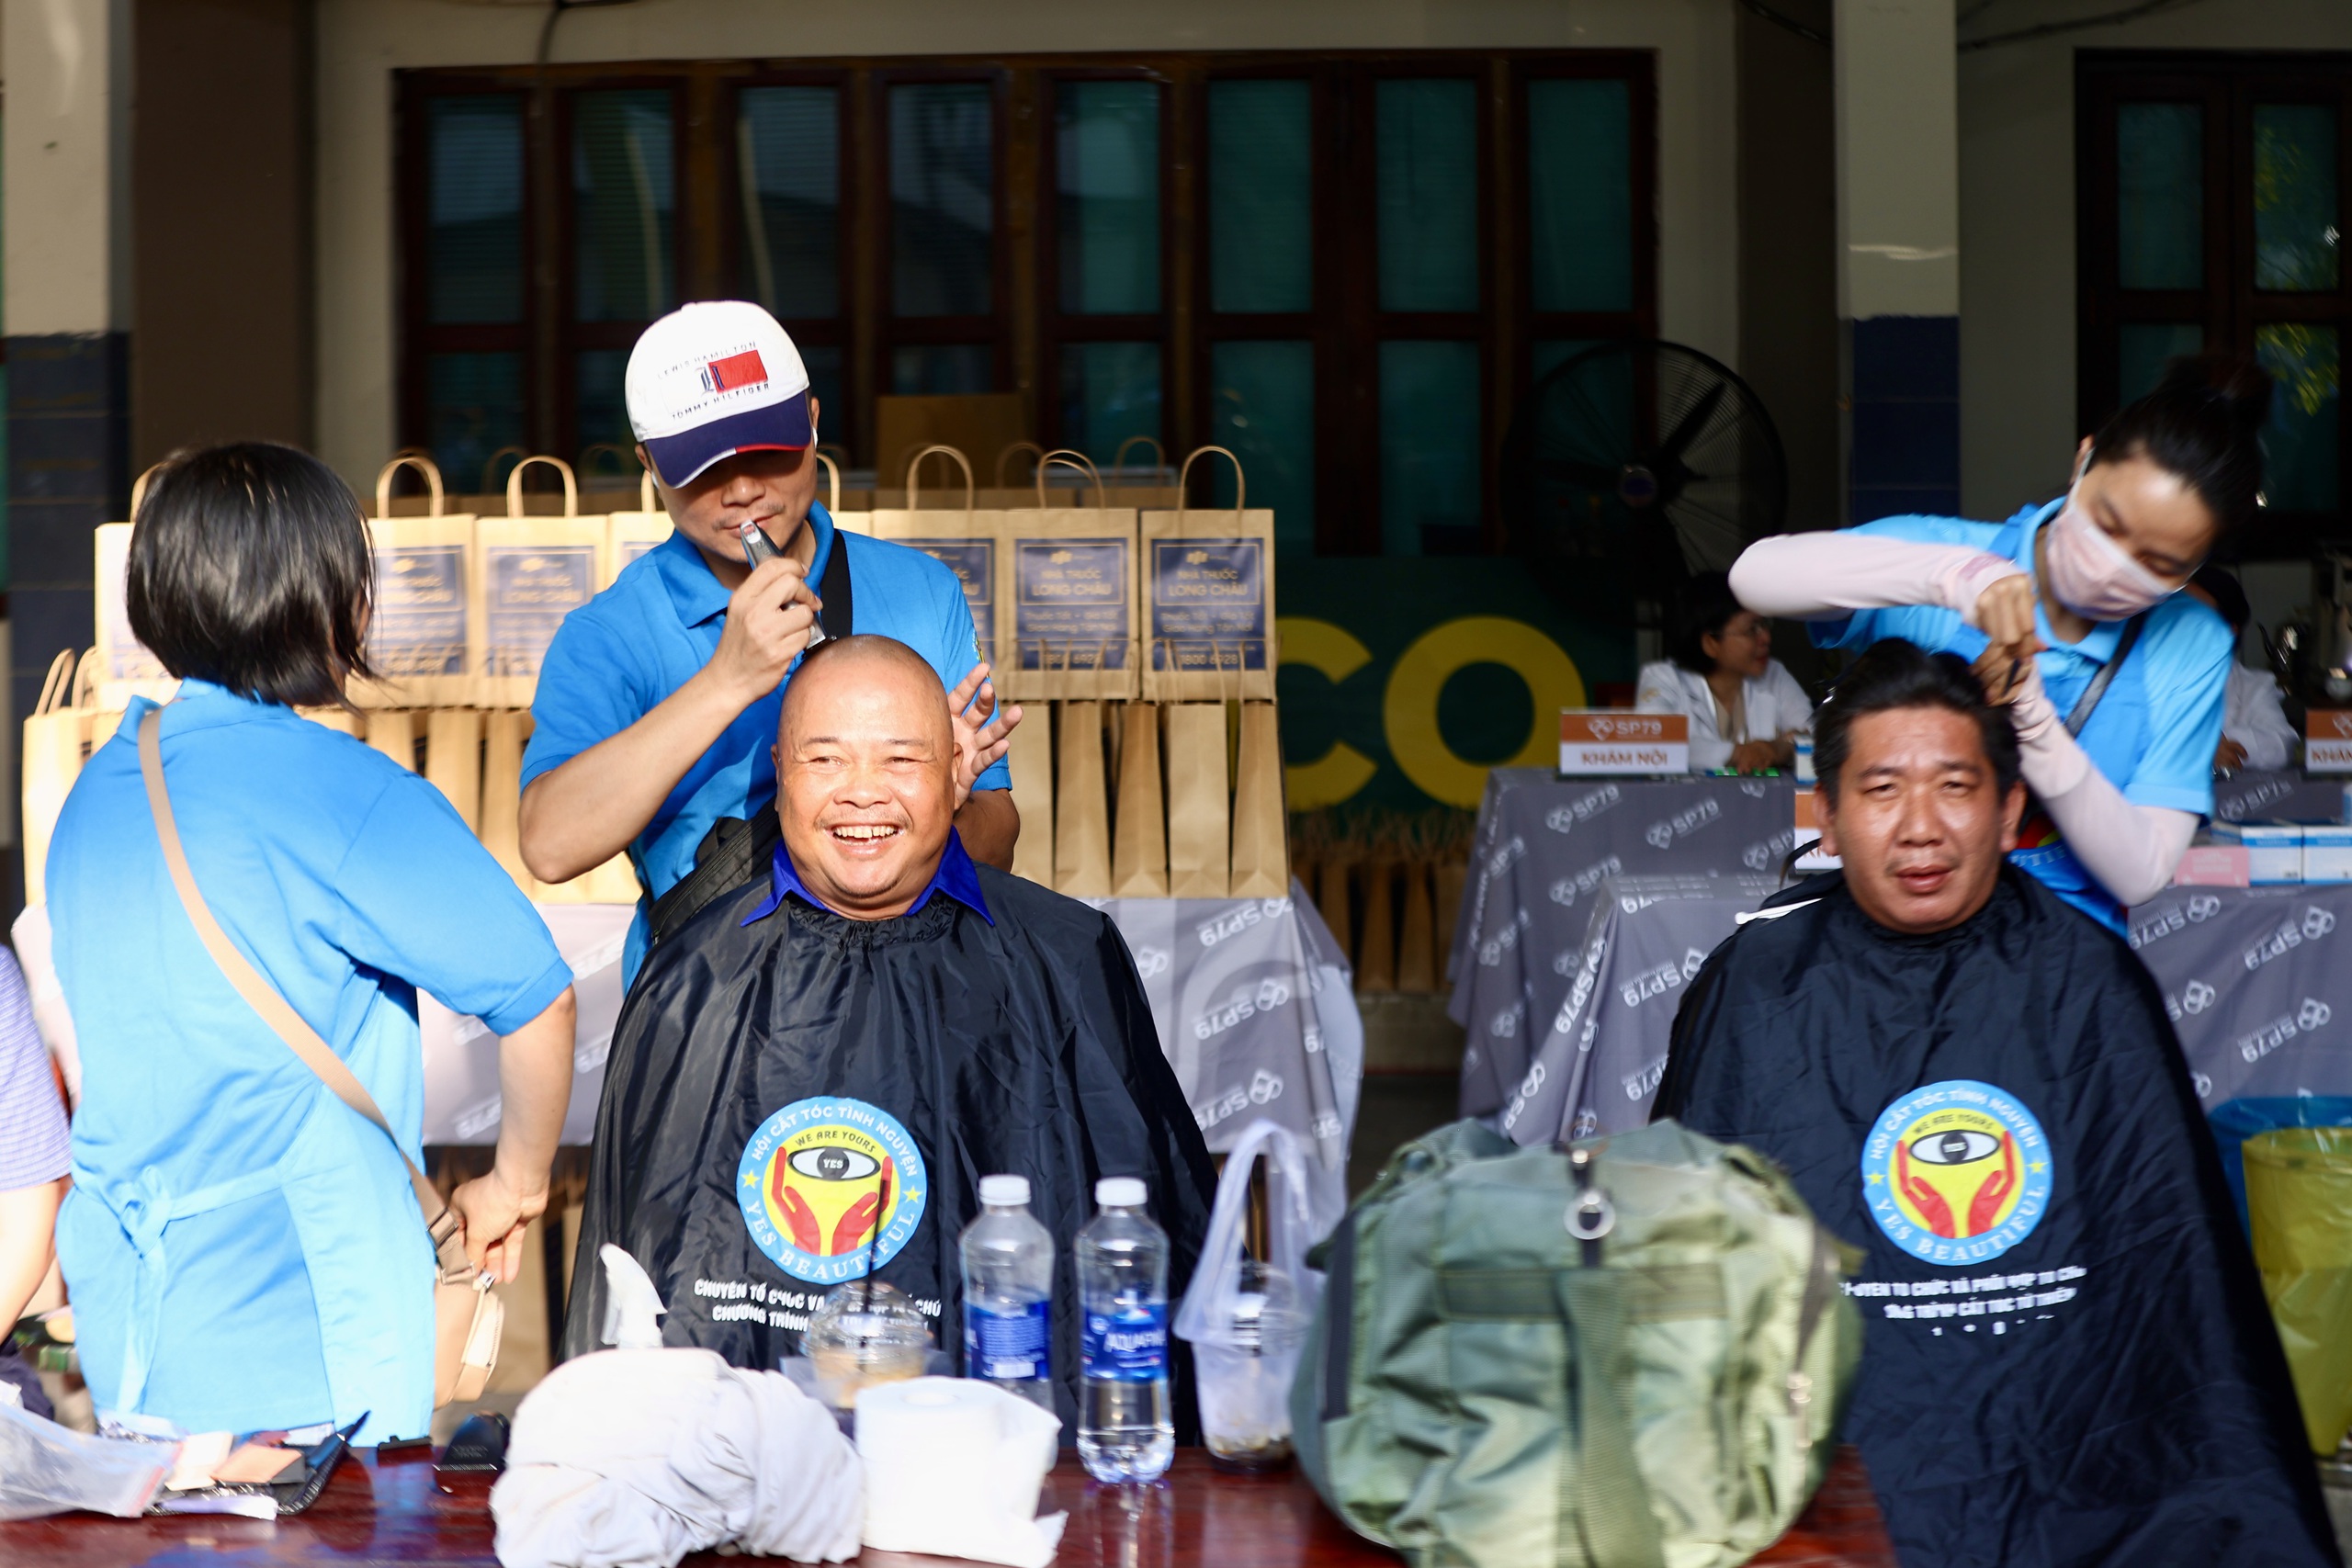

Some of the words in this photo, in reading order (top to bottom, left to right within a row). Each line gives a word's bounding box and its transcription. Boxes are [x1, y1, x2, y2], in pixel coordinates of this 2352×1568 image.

[694, 341, 756, 363] HAMILTON
[672, 400, 708, 420] TOMMY
[713, 382, 770, 403] HILFIGER
[1032, 583, 1071, 596] LONG
[1169, 584, 1207, 596] LONG
[1616, 718, 1662, 735] SP79
[1572, 784, 1620, 819] SP79
[1671, 795, 1720, 834] SP79
[1200, 906, 1261, 947] SP79
[1555, 971, 1595, 1034] SP79
[1623, 970, 1682, 1008] SP79
[1194, 998, 1255, 1040] SP79
[2242, 1021, 2297, 1064] SP79
[752, 1135, 772, 1161] HỘI
[770, 1112, 797, 1137] CẮT
[800, 1104, 833, 1121] TÓC
[837, 1105, 876, 1128] TÌNH
[875, 1122, 918, 1178] NGUYỆN
[795, 1134, 812, 1147] WE
[817, 1131, 838, 1140] ARE
[842, 1131, 876, 1154] YOURS
[823, 1157, 843, 1170] YES
[745, 1200, 777, 1247] YES
[1874, 1198, 1913, 1241] YES
[1915, 1185, 2046, 1261] BEAUTIFUL
[768, 1309, 809, 1334] TRÌNH
